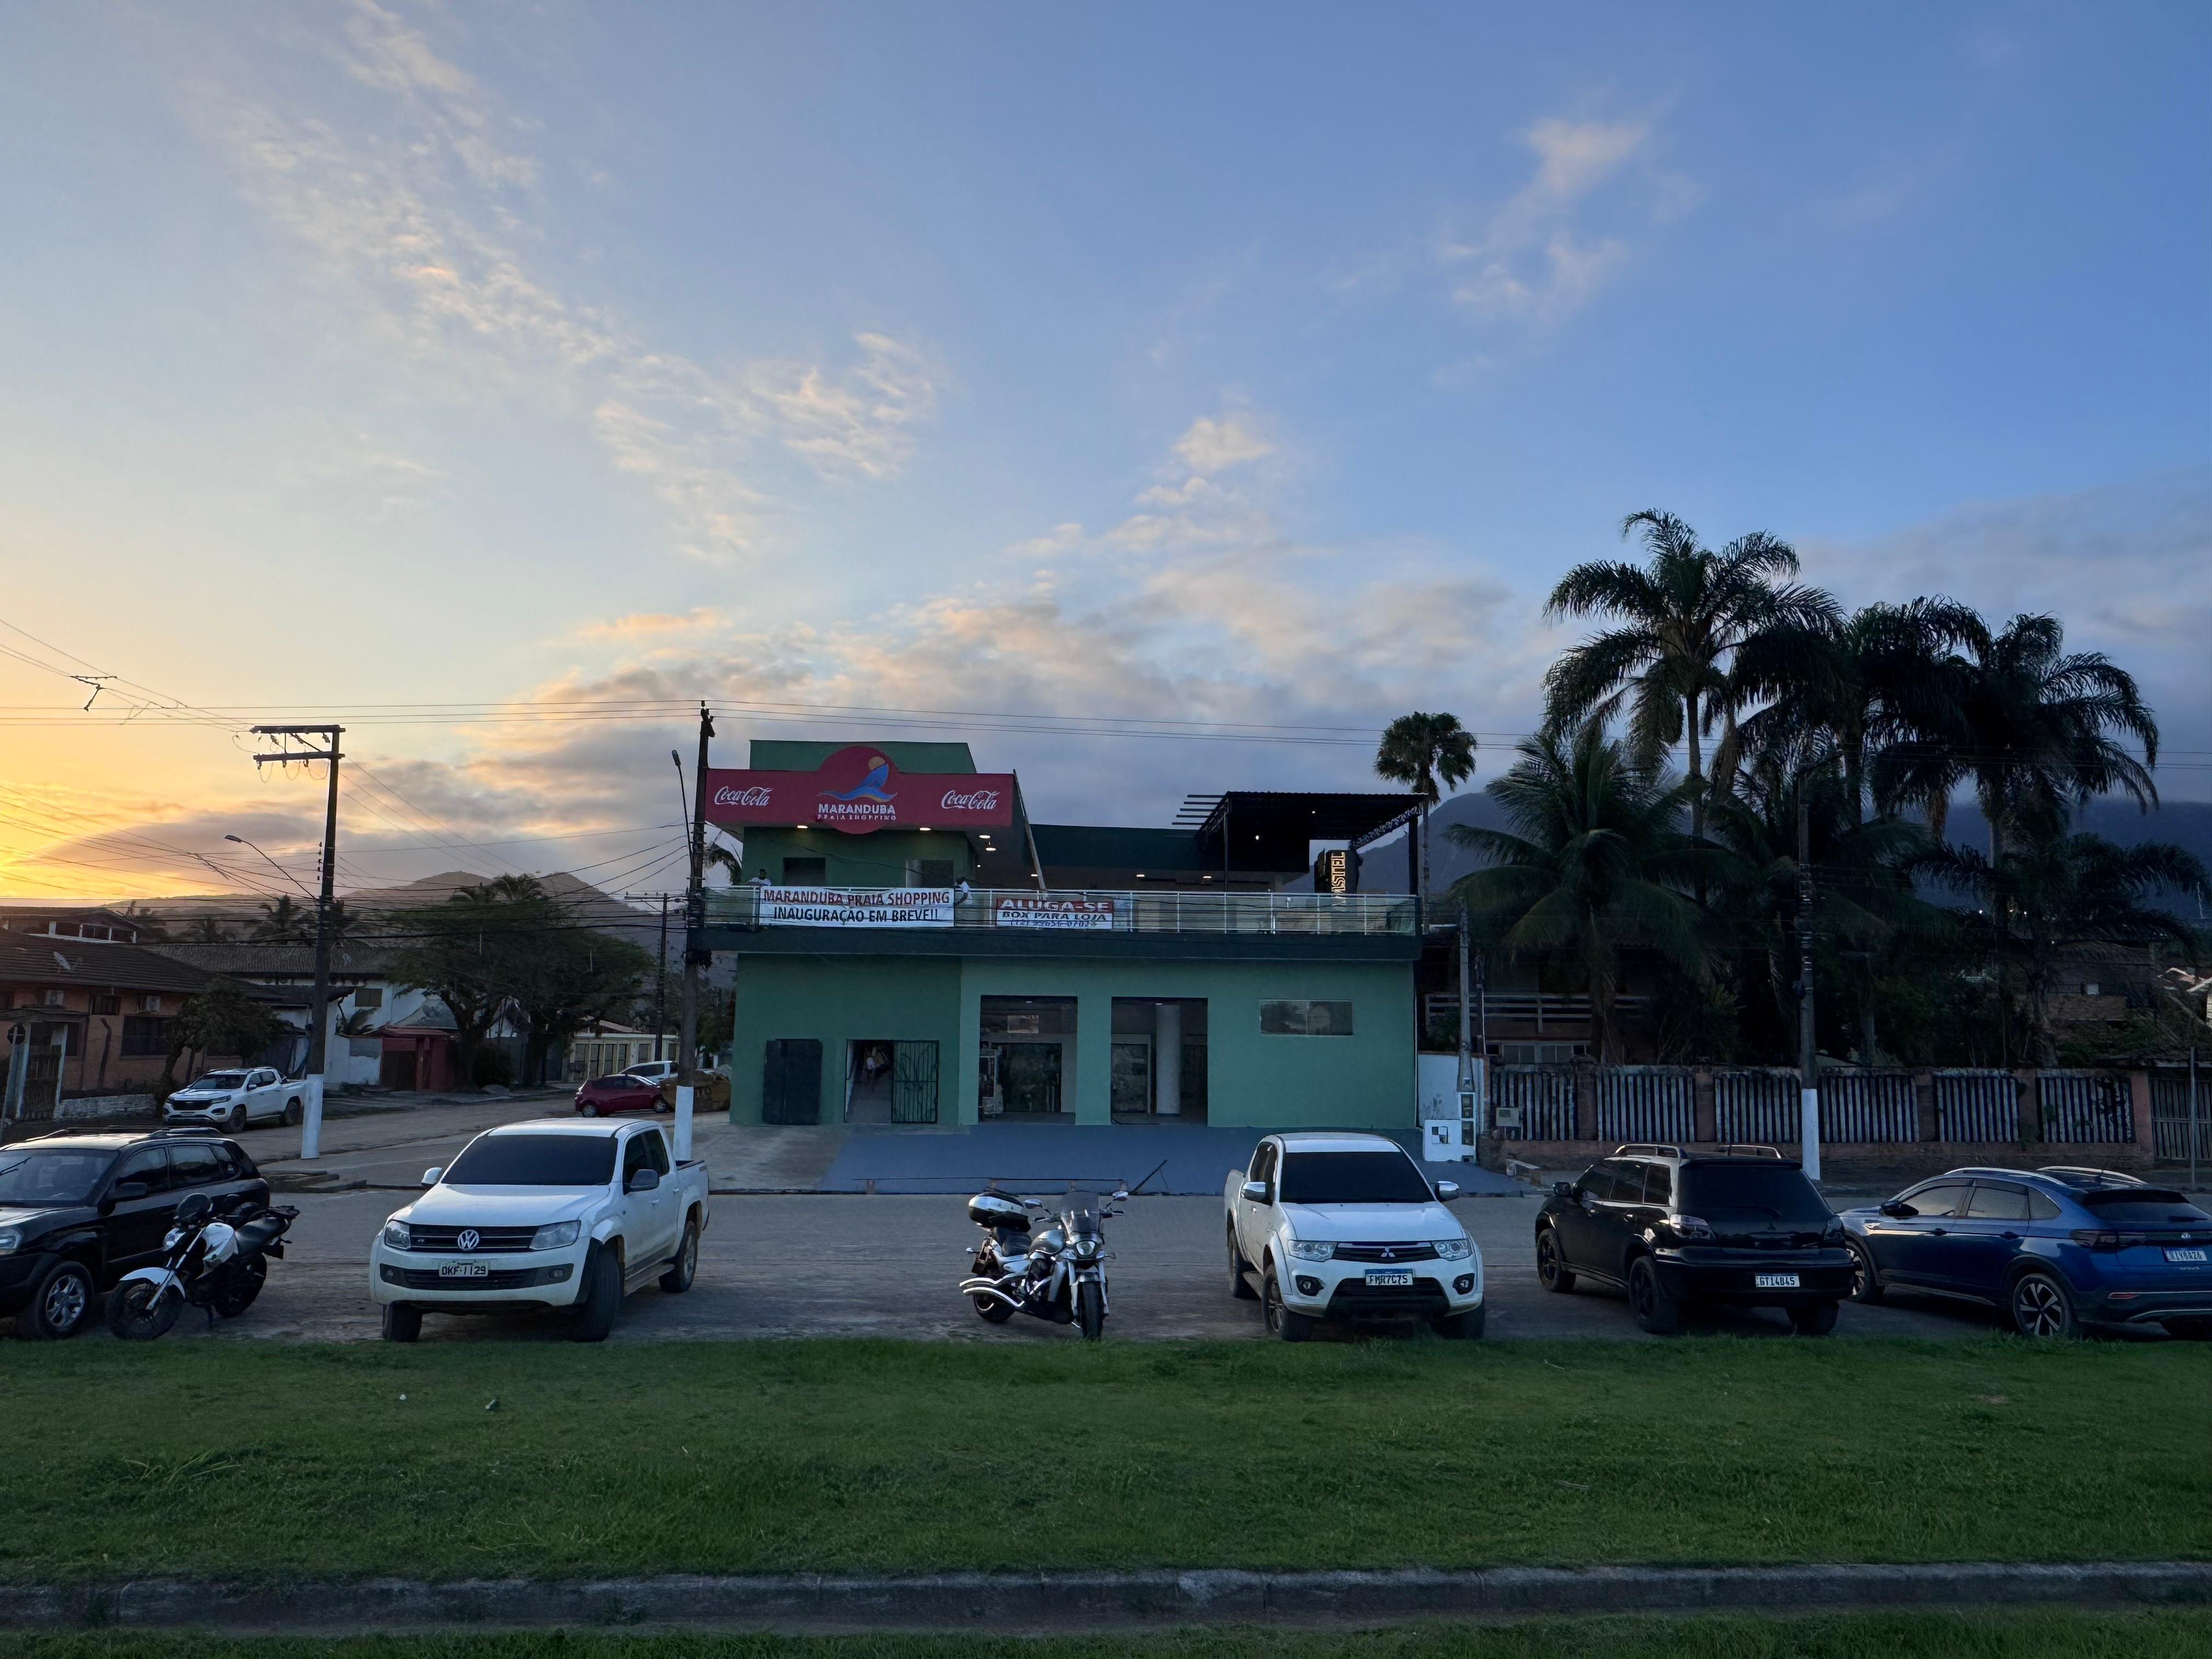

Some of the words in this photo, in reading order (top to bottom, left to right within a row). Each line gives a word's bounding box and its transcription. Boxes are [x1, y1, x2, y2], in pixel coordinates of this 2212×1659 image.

[818, 803, 896, 815] MARANDUBA
[764, 889, 843, 905] MARANDUBA
[847, 893, 884, 906] PRAIA
[887, 891, 950, 906] SHOPPING
[1000, 899, 1109, 912] ALUGA-SE
[868, 910, 887, 922] EM
[1074, 913, 1106, 922] LOJA
